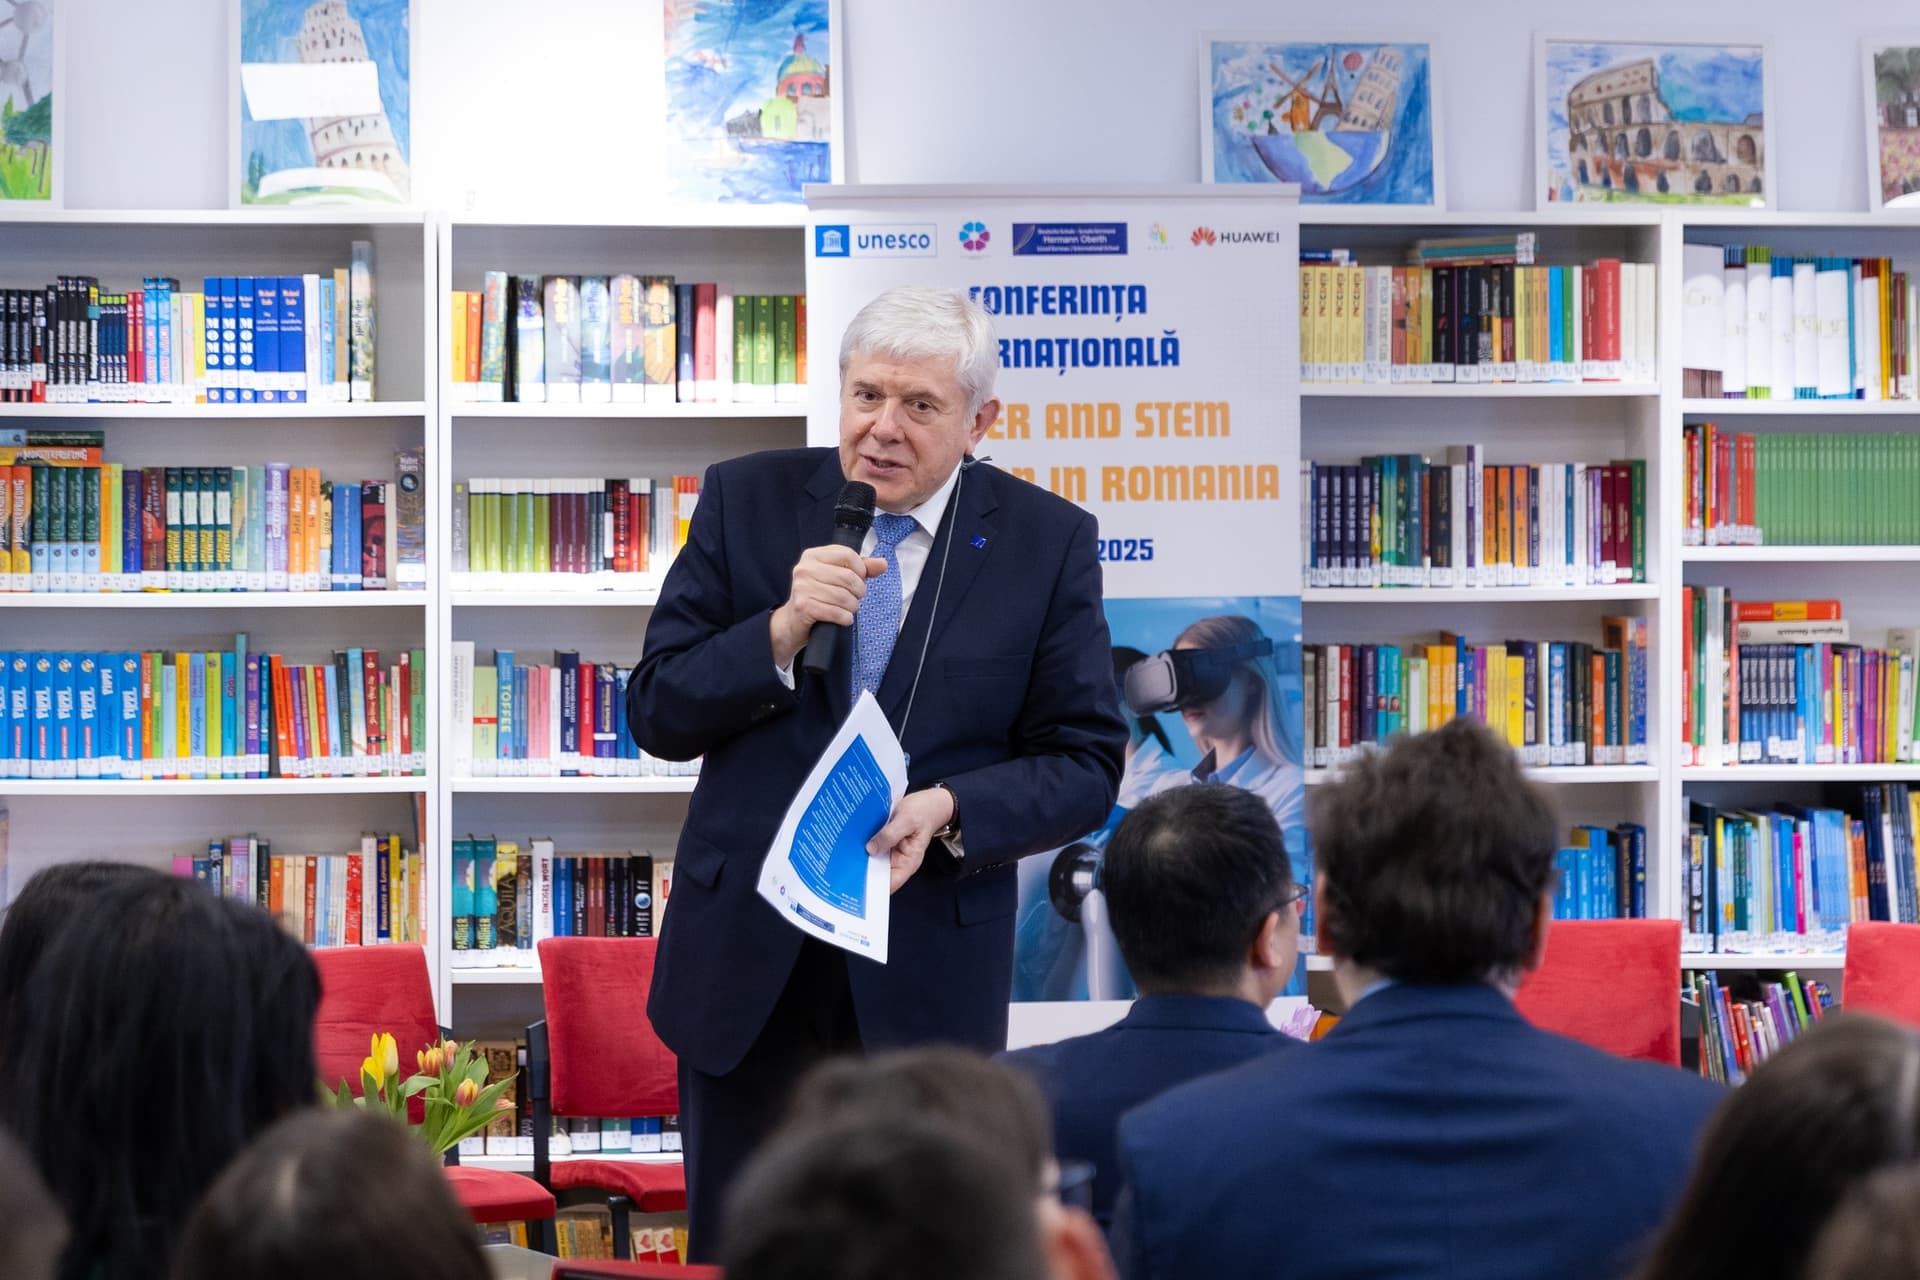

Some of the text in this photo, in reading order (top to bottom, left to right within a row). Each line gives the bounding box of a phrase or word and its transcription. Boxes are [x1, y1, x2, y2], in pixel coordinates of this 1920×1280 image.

[857, 233, 930, 249] unesco
[1043, 235, 1079, 243] Hermann
[1220, 232, 1280, 243] HUAWEI
[998, 329, 1180, 376] RNAȚIONALĂ
[1045, 402, 1121, 439] AND
[1135, 401, 1230, 438] STEM
[1050, 467, 1087, 502] IN
[1102, 464, 1279, 502] ROMANIA
[1098, 539, 1153, 561] 2025
[501, 684, 511, 733] TOFFEE
[541, 858, 550, 882] WORT
